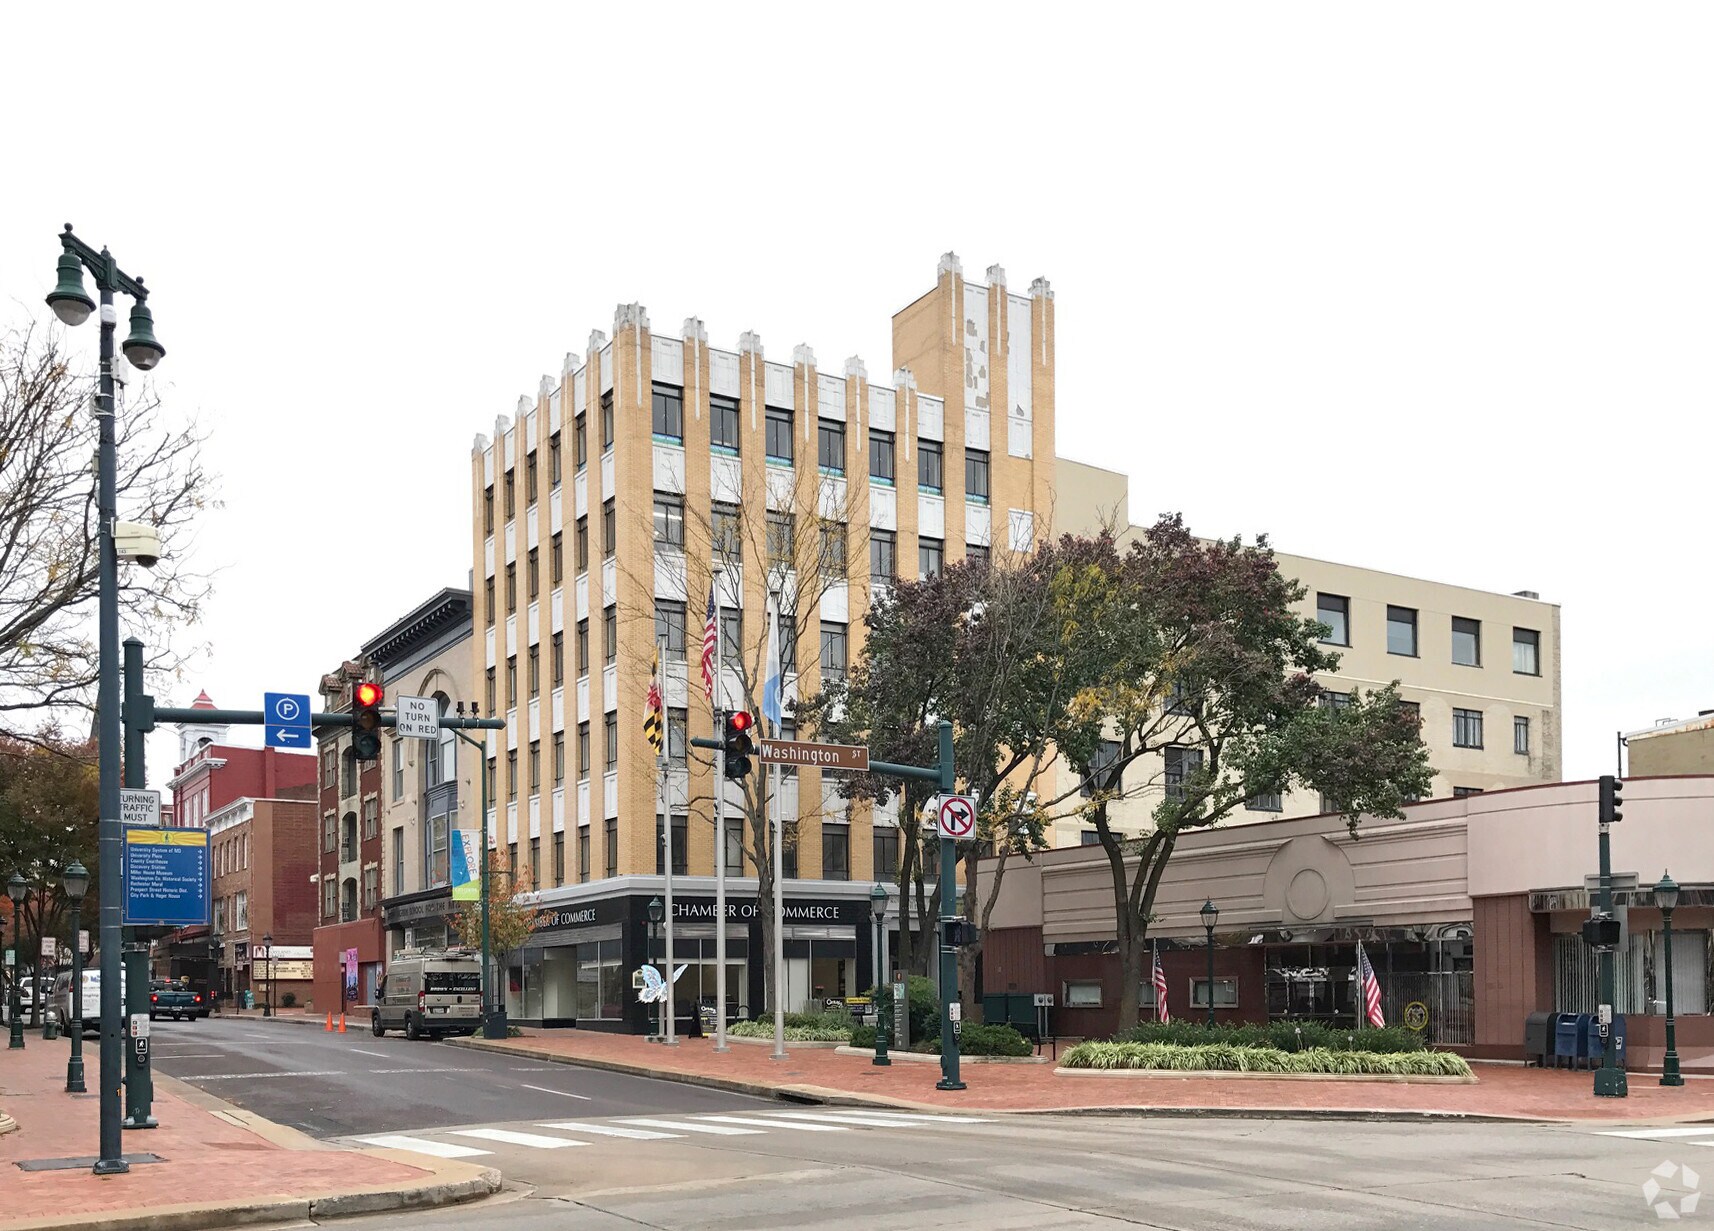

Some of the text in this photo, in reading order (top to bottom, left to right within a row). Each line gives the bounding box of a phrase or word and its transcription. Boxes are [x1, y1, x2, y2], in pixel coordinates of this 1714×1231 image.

[284, 704, 294, 715] P
[410, 702, 424, 710] NO
[406, 712, 430, 722] TURN
[400, 723, 437, 734] ON RED
[761, 744, 861, 766] Washington ST
[120, 794, 155, 804] URNING
[120, 804, 154, 813] TRAFFIC
[124, 813, 148, 822] MUST
[462, 834, 478, 875] EXPLORE
[552, 914, 560, 926] OF
[560, 908, 596, 925] COMMERCE
[741, 904, 759, 917] OF
[772, 906, 840, 919] MMERCE
